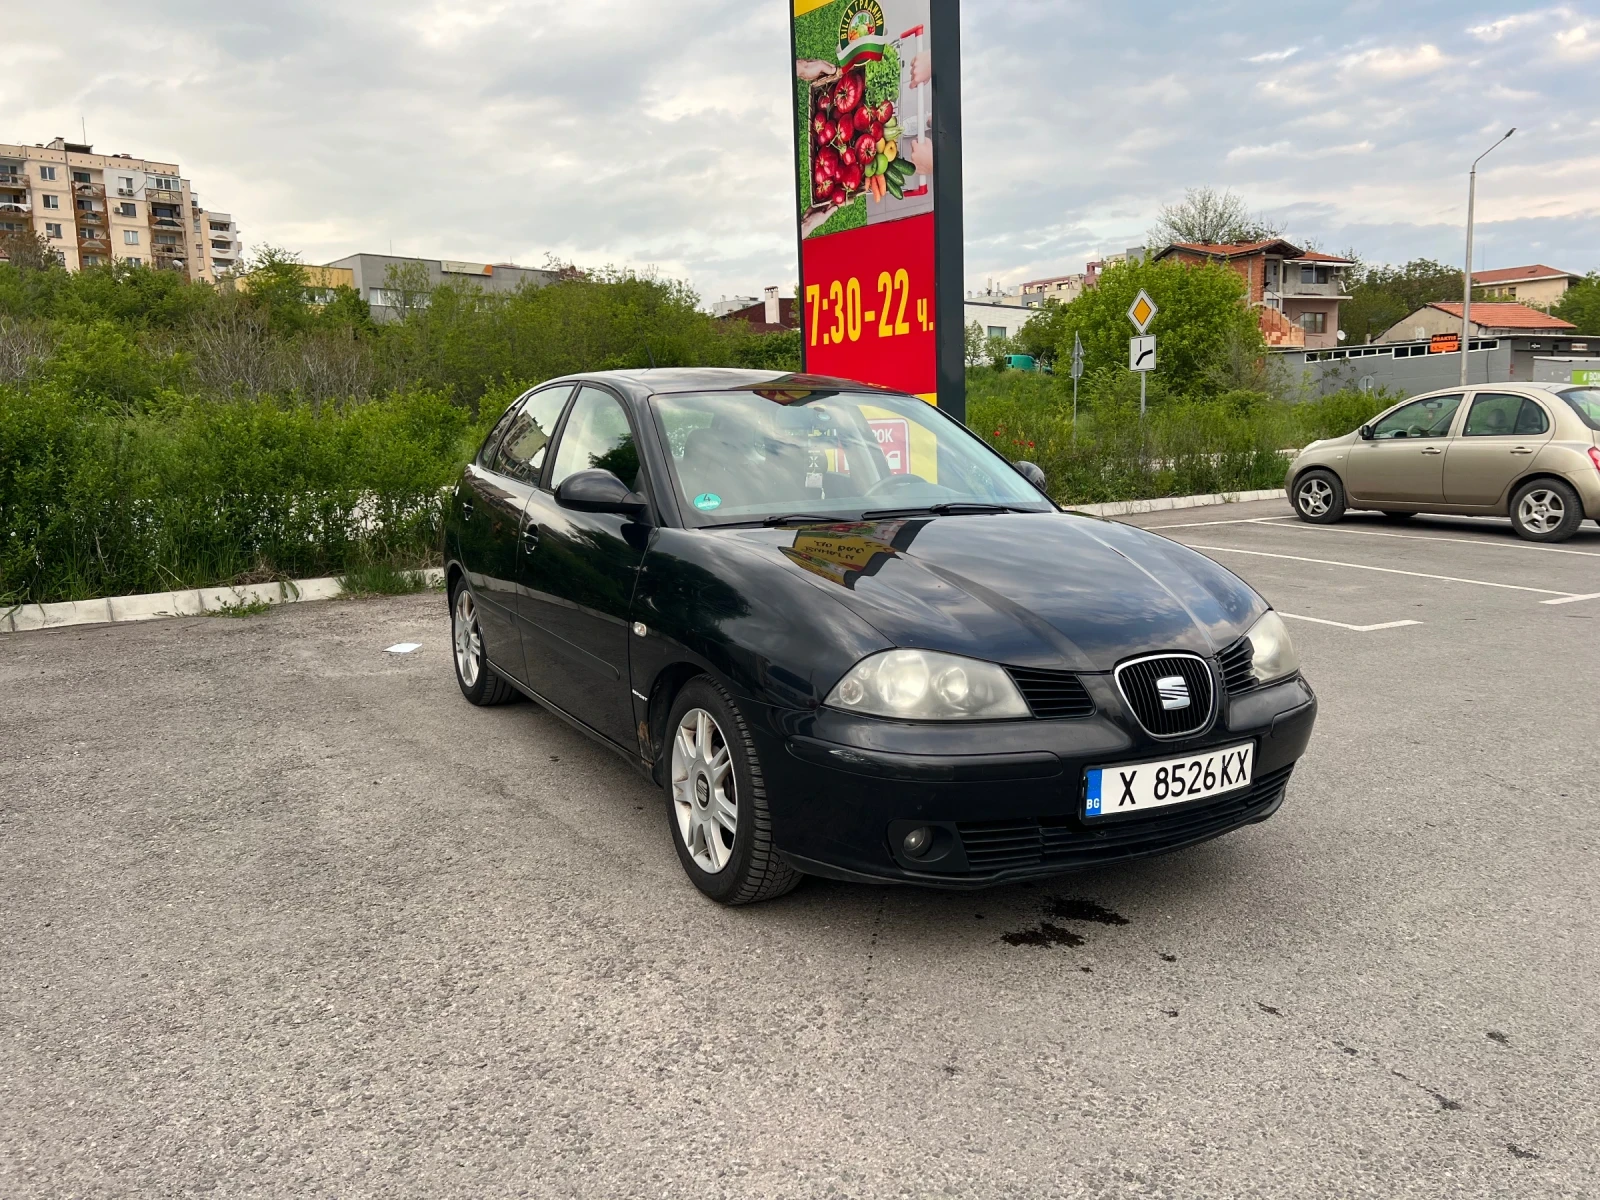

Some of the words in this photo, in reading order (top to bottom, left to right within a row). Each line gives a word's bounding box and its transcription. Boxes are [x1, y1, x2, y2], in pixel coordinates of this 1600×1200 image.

[840, 9, 854, 40] BILLA
[806, 268, 910, 347] 7:30-22
[1086, 798, 1100, 810] BG
[1118, 770, 1137, 807] X
